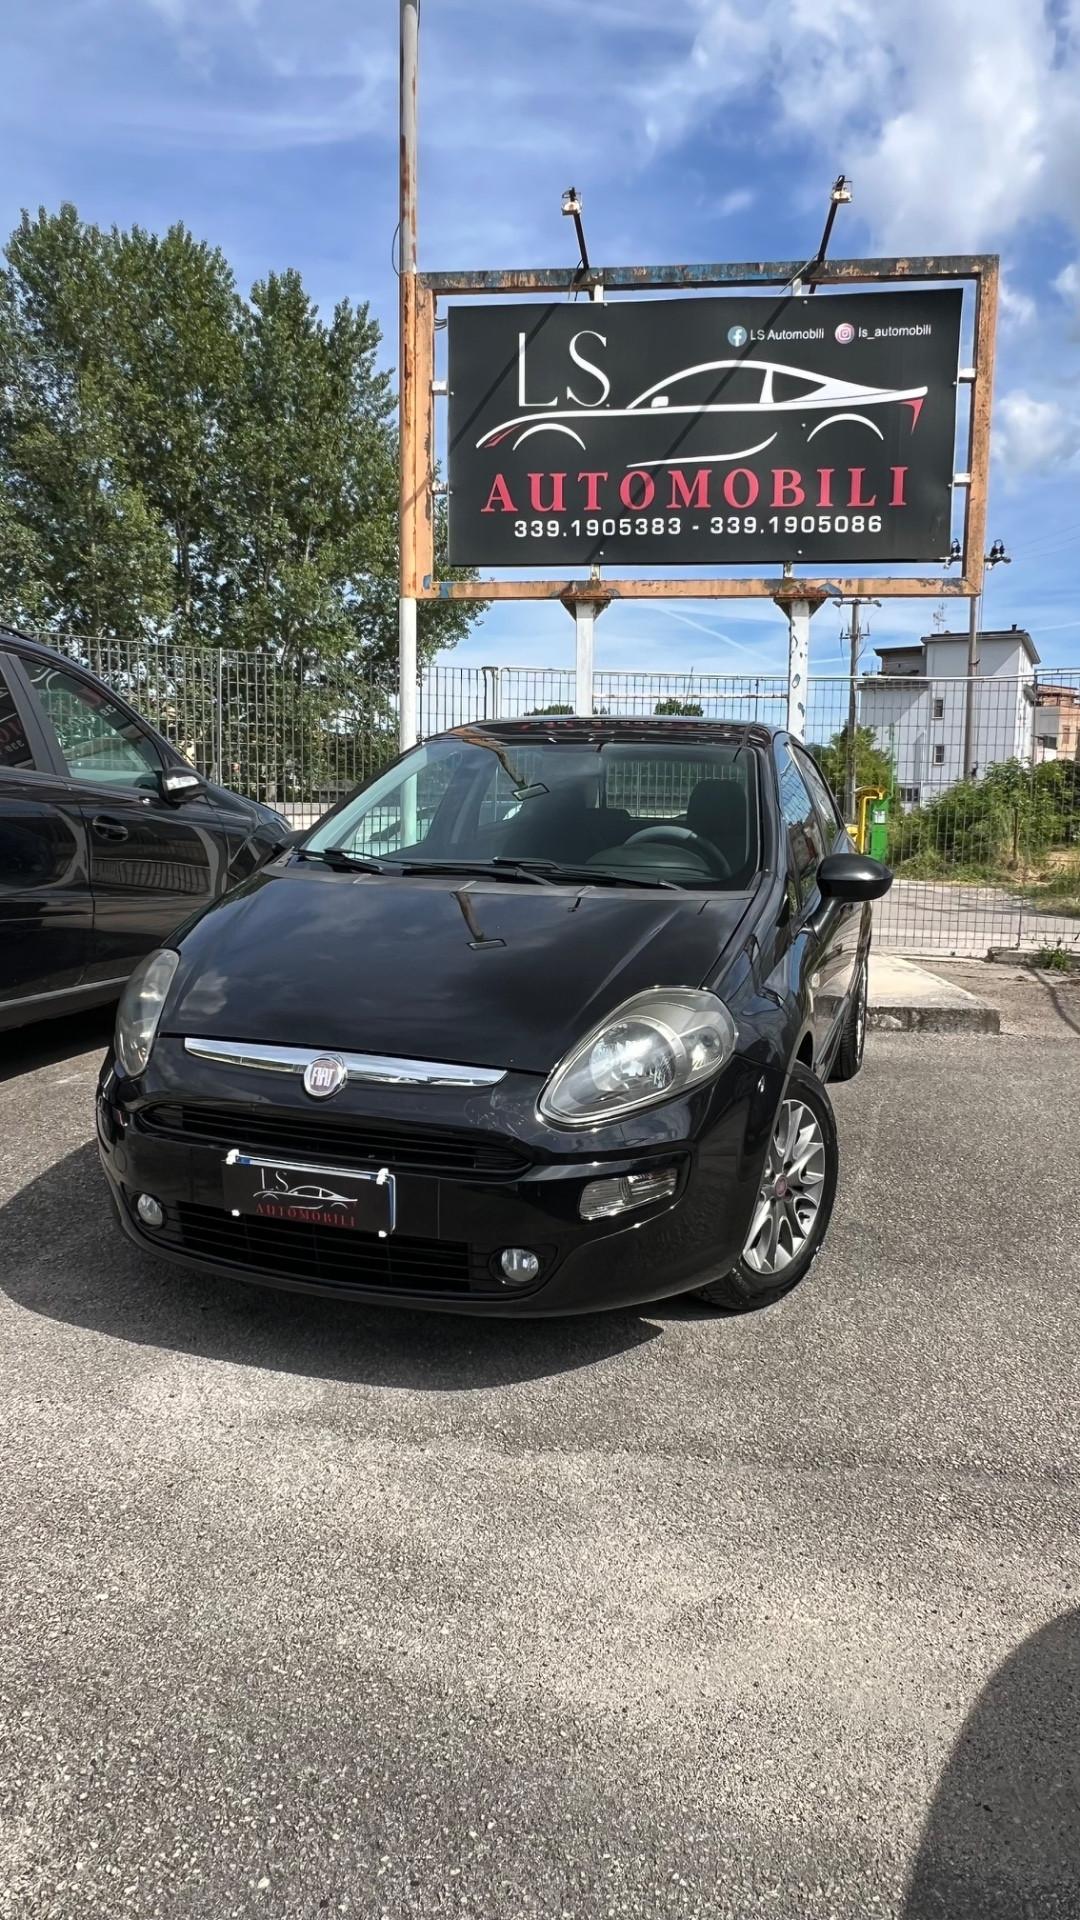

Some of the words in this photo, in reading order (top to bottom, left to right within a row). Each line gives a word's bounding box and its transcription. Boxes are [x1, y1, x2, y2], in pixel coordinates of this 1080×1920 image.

[750, 329, 765, 341] LS
[767, 328, 824, 340] Automobili
[858, 324, 931, 340] ls_automobili
[480, 466, 909, 513] AUTOMOBILI
[514, 517, 681, 538] 339.1905383
[710, 515, 882, 535] 339.1905086
[311, 1066, 336, 1087] FIAT
[255, 1203, 356, 1227] AUTOMOBILI
